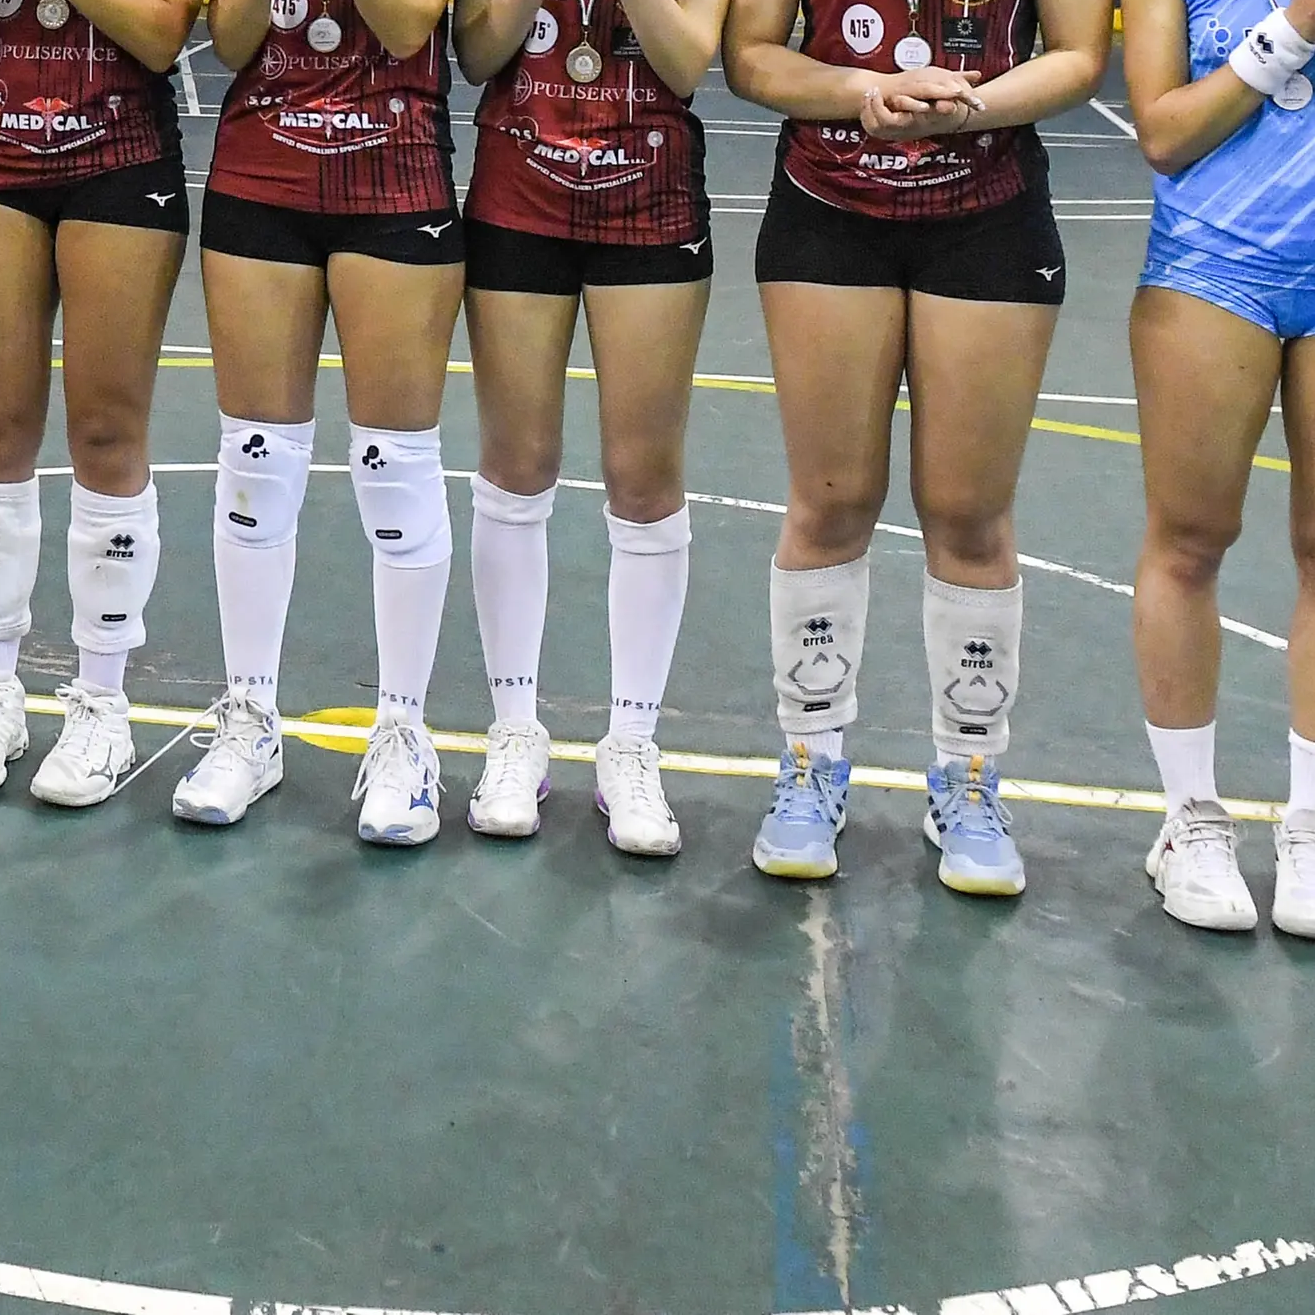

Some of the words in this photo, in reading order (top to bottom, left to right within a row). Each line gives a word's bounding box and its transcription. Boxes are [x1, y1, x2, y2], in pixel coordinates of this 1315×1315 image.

[850, 18, 876, 39] 475°
[2, 45, 118, 62] PULISERVICE
[532, 81, 658, 103] PULISERVICE
[822, 127, 864, 144] S.O.S.
[612, 697, 661, 711] IPSTA
